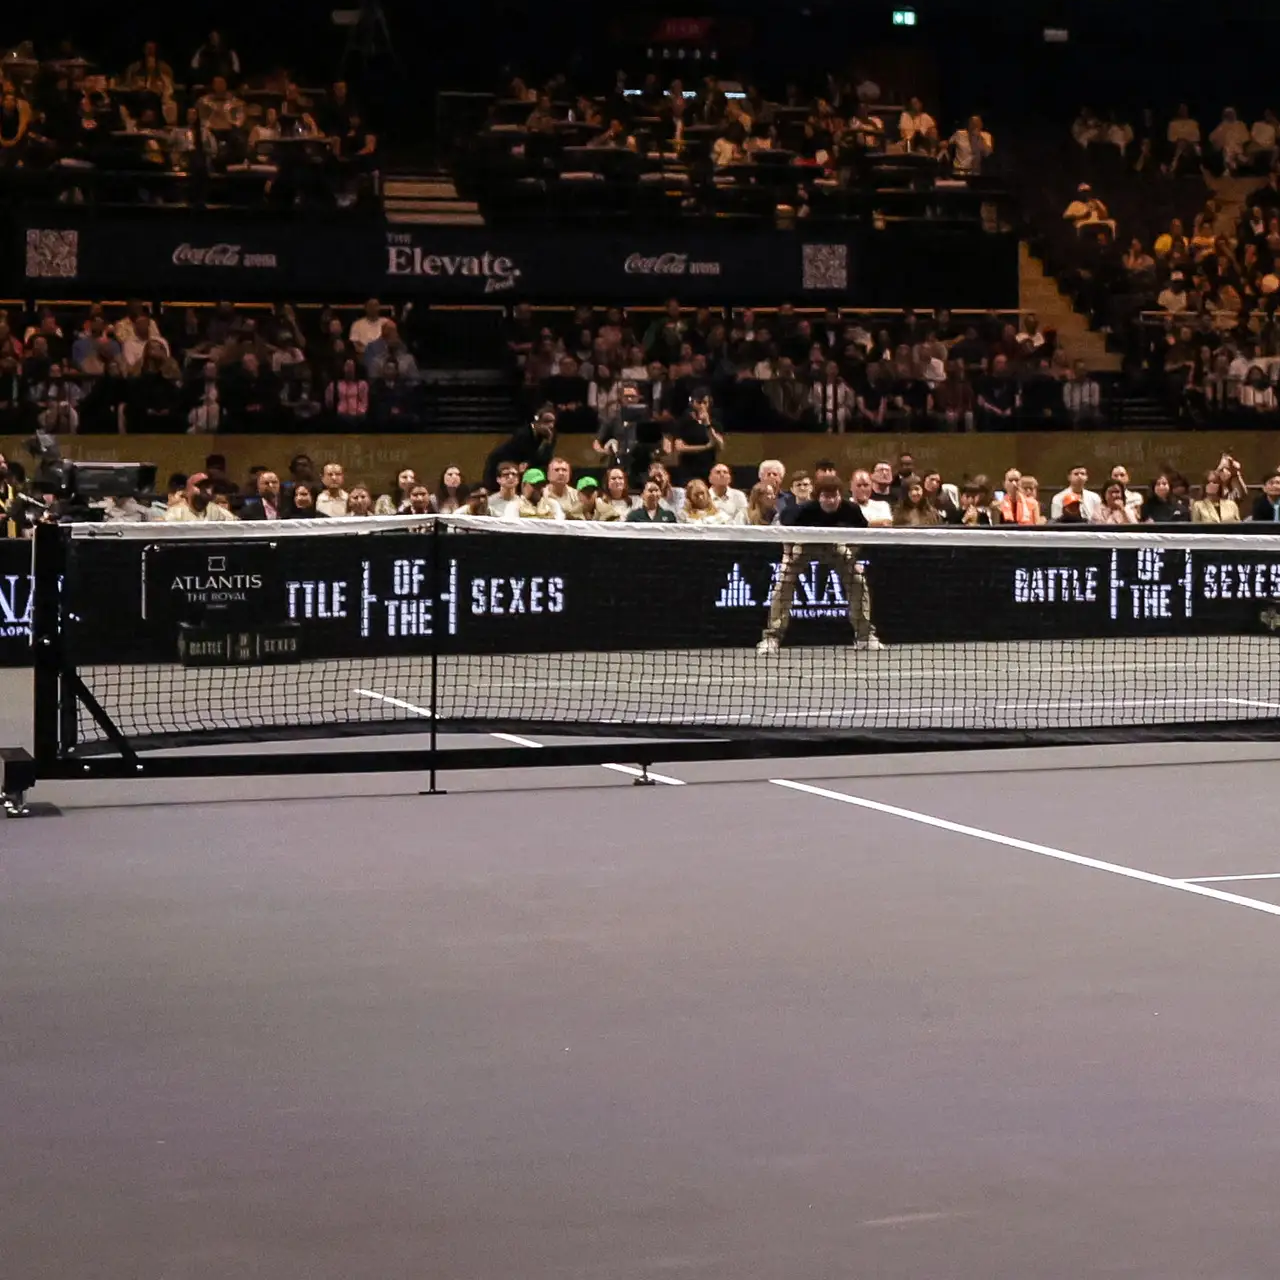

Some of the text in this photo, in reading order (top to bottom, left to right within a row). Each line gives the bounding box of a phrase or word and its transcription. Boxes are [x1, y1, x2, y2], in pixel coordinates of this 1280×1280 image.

[171, 574, 262, 590] ATLANTIS
[187, 592, 247, 603] THE ROYAL
[286, 559, 565, 636] TTLE OF THE SEXES
[1014, 567, 1098, 602] BATTLE
[1130, 584, 1172, 619] THE
